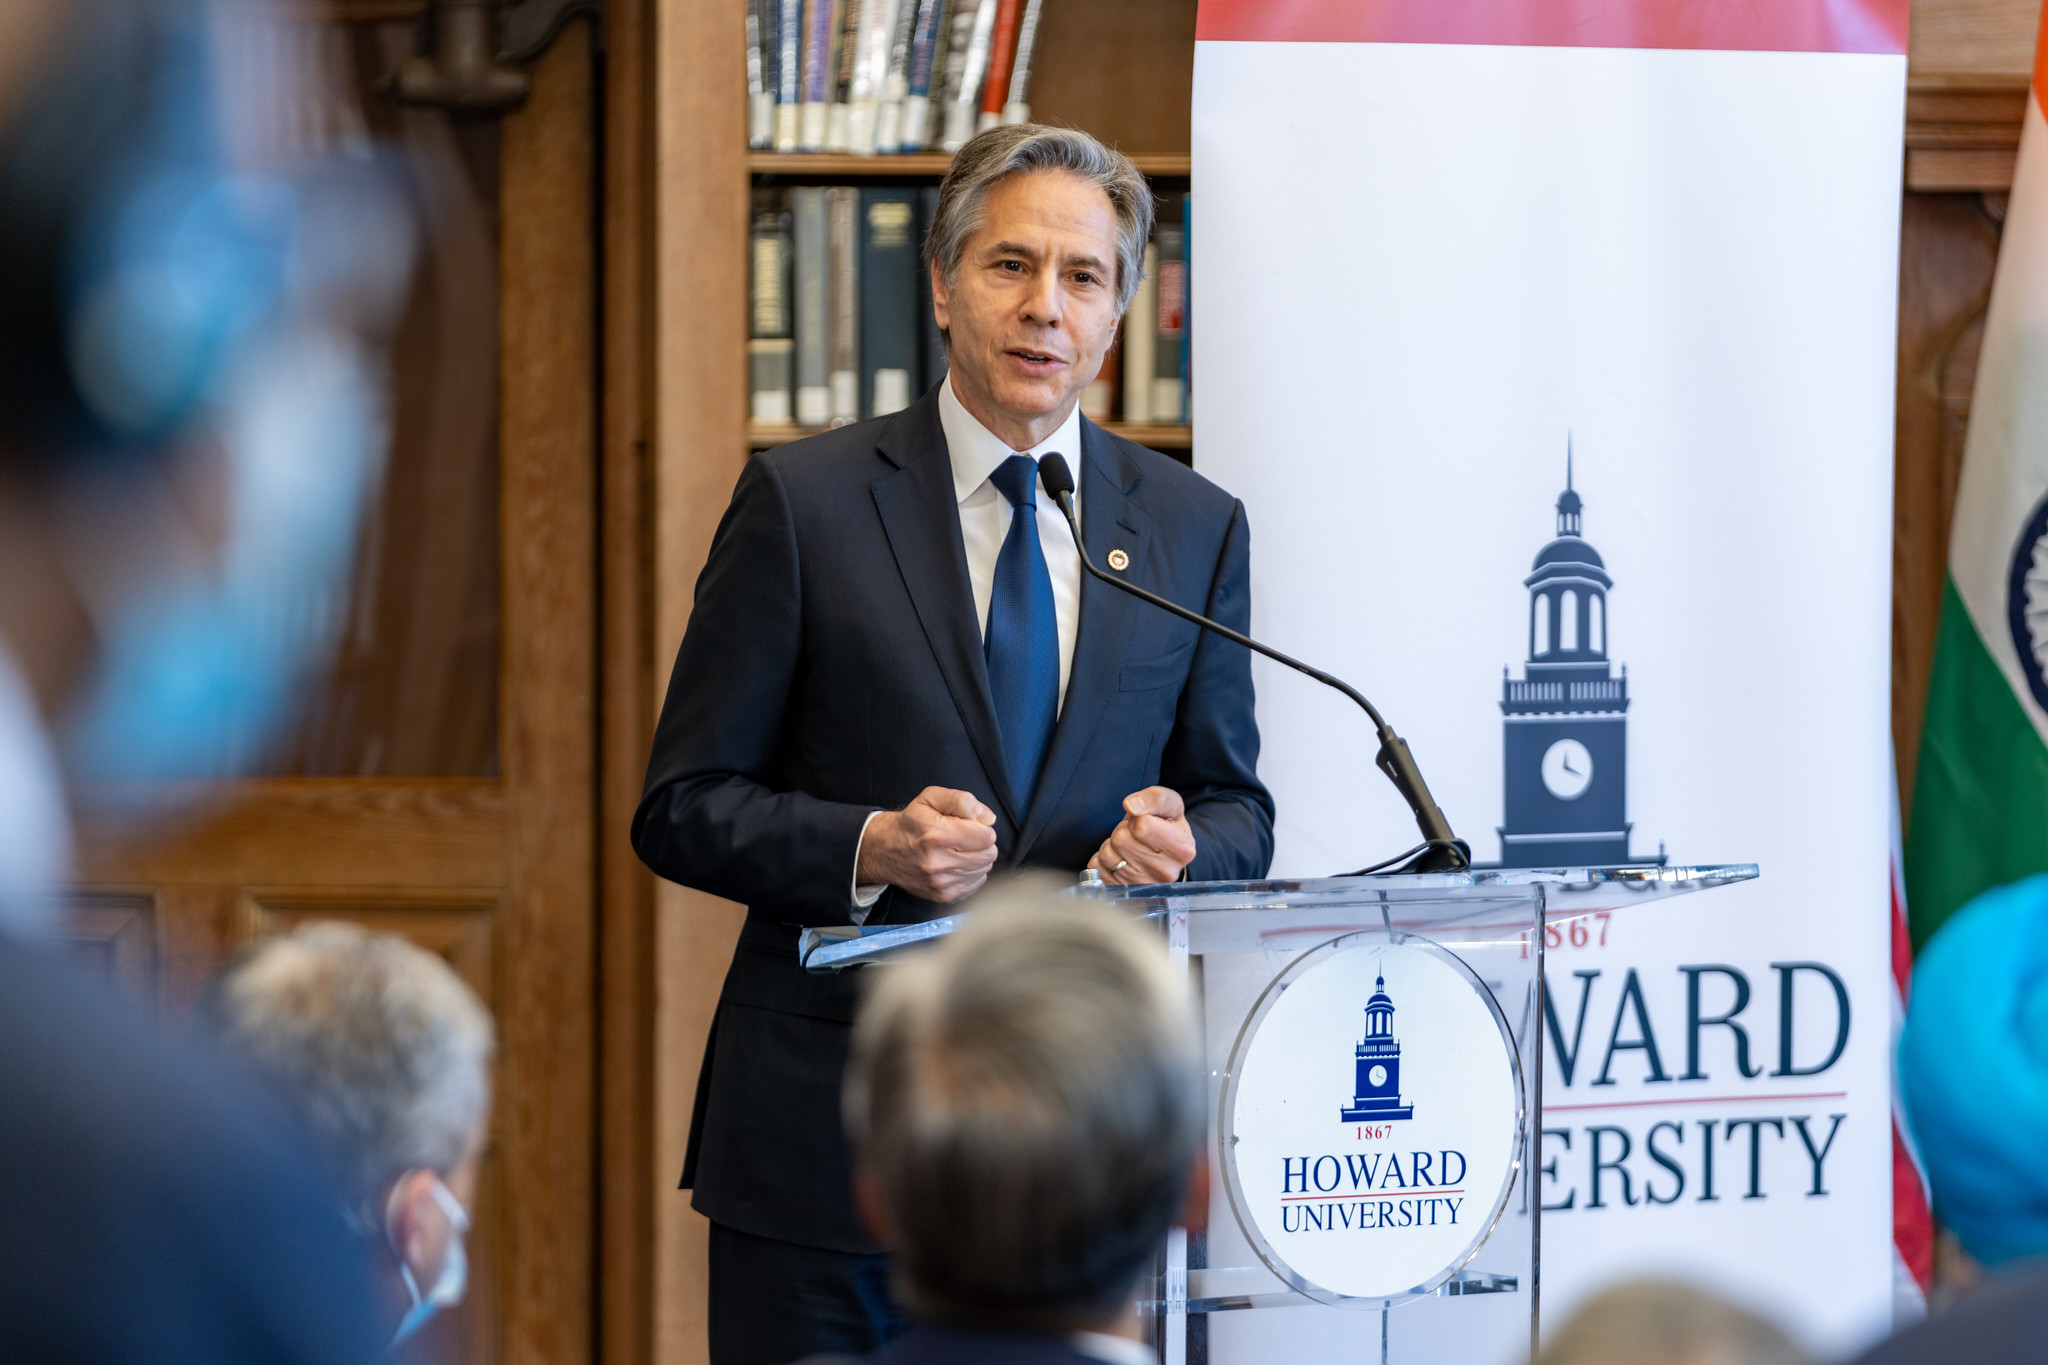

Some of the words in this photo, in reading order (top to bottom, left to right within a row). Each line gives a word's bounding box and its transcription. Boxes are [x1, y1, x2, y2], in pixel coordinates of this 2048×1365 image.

[1514, 960, 1851, 1088] WARD
[1355, 1124, 1392, 1140] 1867
[1281, 1150, 1467, 1193] HOWARD
[1519, 1112, 1848, 1215] ERSITY
[1280, 1197, 1464, 1233] UNIVERSITY
